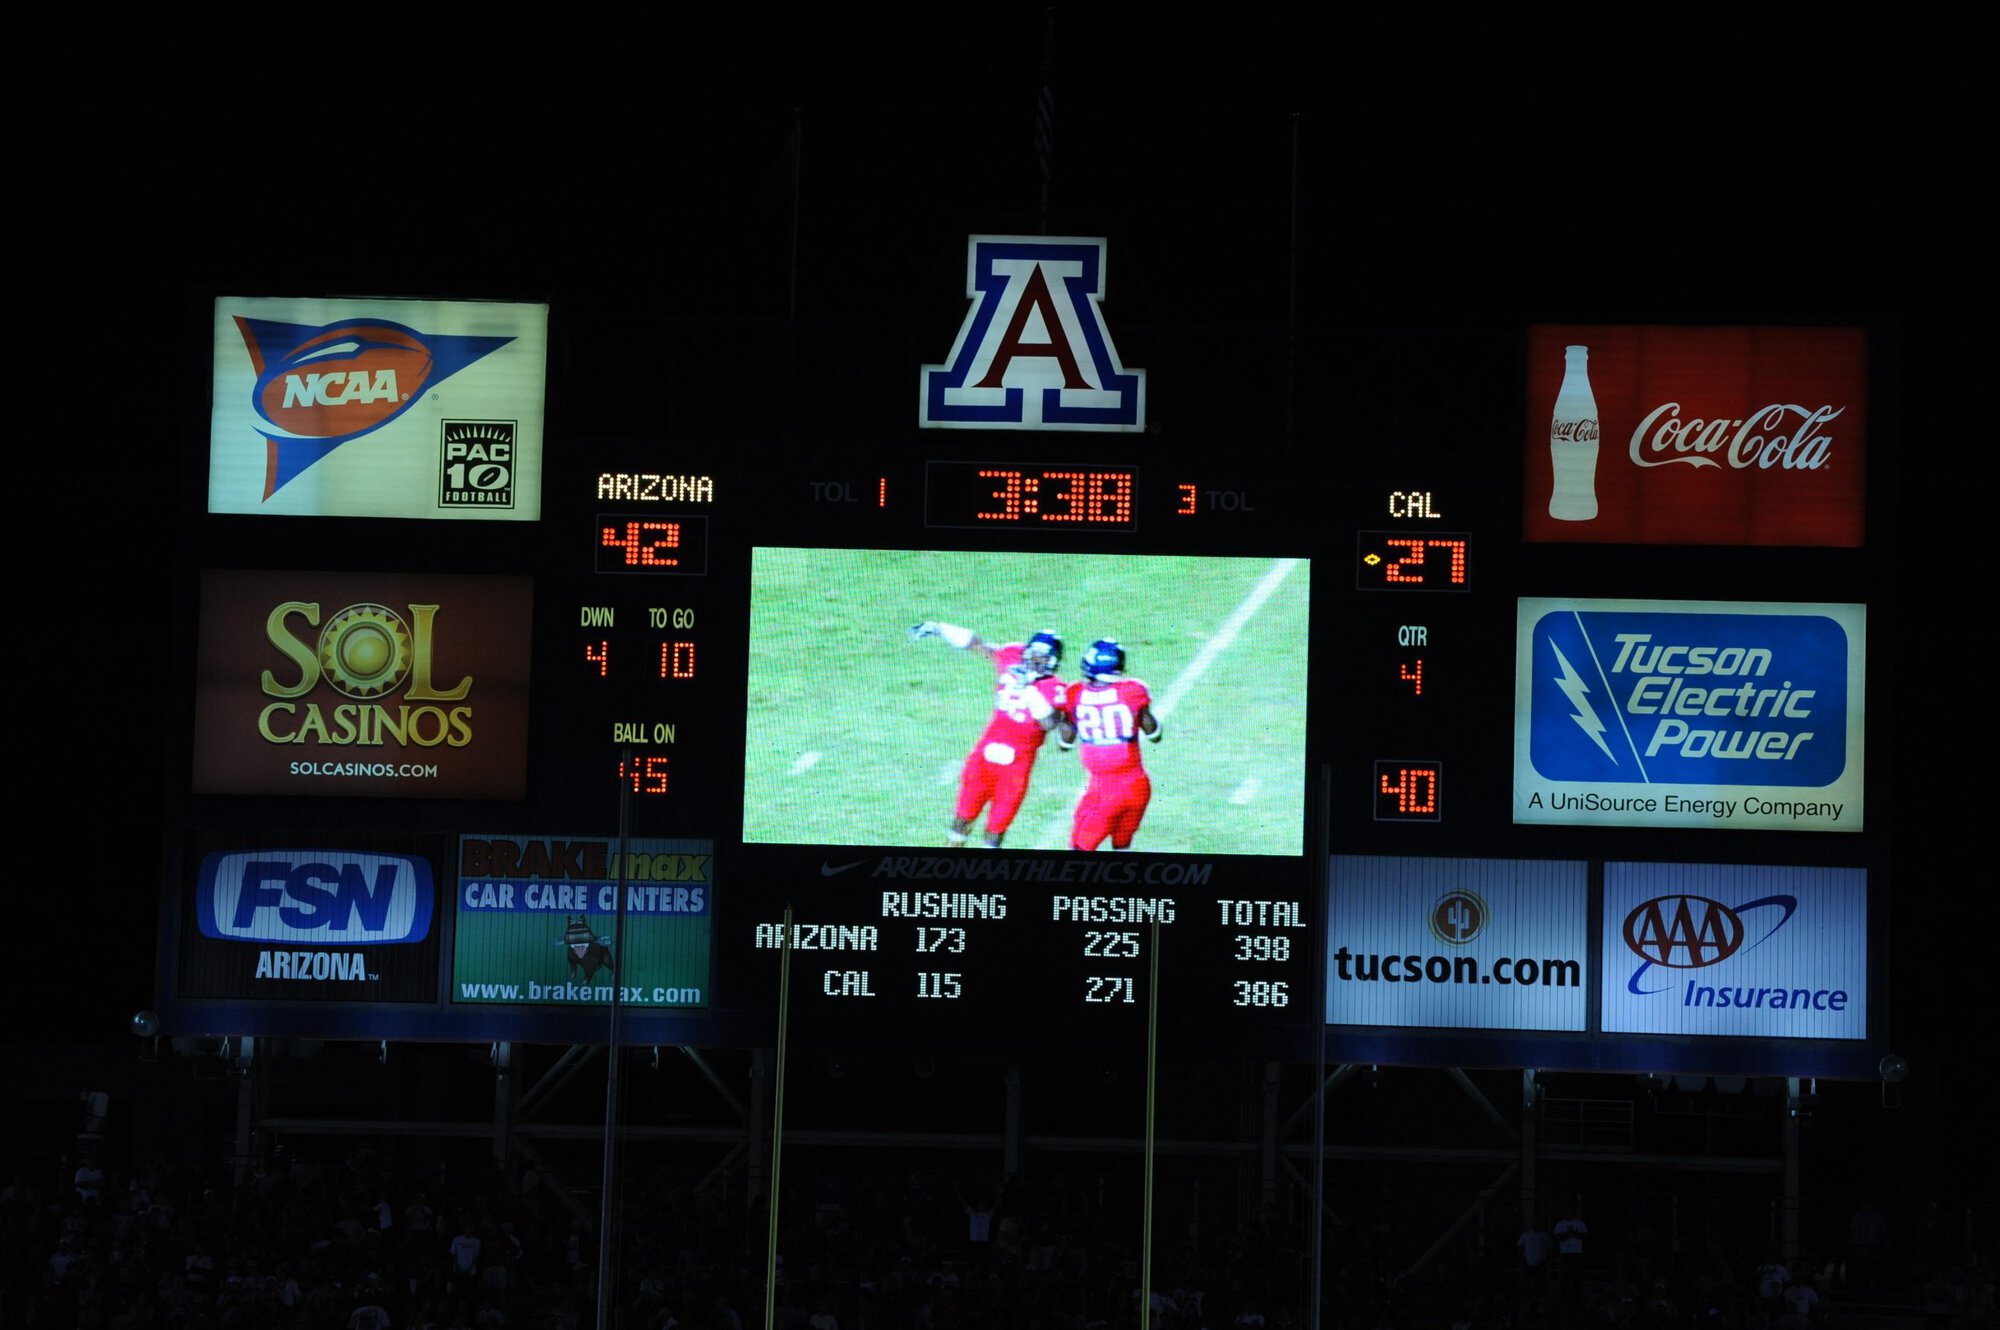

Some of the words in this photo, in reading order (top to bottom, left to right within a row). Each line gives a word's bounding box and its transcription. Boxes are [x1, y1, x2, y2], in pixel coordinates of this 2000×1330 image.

[919, 234, 1147, 433] A
[282, 369, 399, 409] NCAA
[1628, 401, 1847, 471] Coca-Cola
[446, 443, 510, 461] PAC
[446, 463, 510, 490] 10
[598, 473, 713, 502] ARIZONA
[445, 491, 508, 503] FOOTBALL
[809, 481, 859, 503] TOL
[878, 476, 886, 508] 1
[976, 470, 1132, 523] 3:38
[1177, 484, 1197, 515] 3
[1205, 490, 1255, 513] TOL
[1388, 491, 1441, 519] CAL
[601, 521, 681, 567] 42
[1385, 539, 1466, 584] 27
[580, 606, 615, 628] DWN
[649, 607, 668, 629] TO
[672, 608, 695, 630] GO
[1397, 625, 1428, 647] QTR
[260, 601, 475, 701] SOL
[586, 640, 608, 678] 4
[660, 641, 696, 679] 10
[1611, 633, 1773, 677] Tucson
[1400, 659, 1424, 696] 4
[1626, 676, 1817, 719] Electric
[257, 702, 473, 748] CASINOS
[613, 722, 649, 744] BALL
[653, 723, 676, 745] ON
[1644, 718, 1815, 761] Power
[290, 761, 438, 778] SOLCASINOS.COM
[1381, 768, 1436, 814] 40
[1528, 792, 1544, 810] A
[1551, 793, 1657, 812] UniSource
[1665, 795, 1737, 817] Energy
[1744, 797, 1844, 820] Company
[870, 855, 1214, 886] ARIZONAATHLETICS.COM
[232, 862, 399, 932] FSN
[464, 882, 515, 909] CAR
[524, 884, 588, 910] CARE
[881, 891, 1007, 920] RUSHING
[1053, 895, 1176, 924] PASSING
[1217, 899, 1307, 928] TOTAL
[915, 926, 967, 953] 173
[1083, 930, 1140, 958] 225
[1634, 896, 1737, 967] AAA
[1234, 935, 1291, 962] 398
[255, 949, 366, 982] ARIZONA
[1333, 946, 1581, 987] tucson.com
[460, 980, 702, 1004] www.brakemax.com
[823, 970, 876, 997] CAL
[917, 972, 962, 999] 115
[1085, 976, 1136, 1004] 271
[1232, 980, 1289, 1007] 386
[1683, 979, 1849, 1012] Insurance
